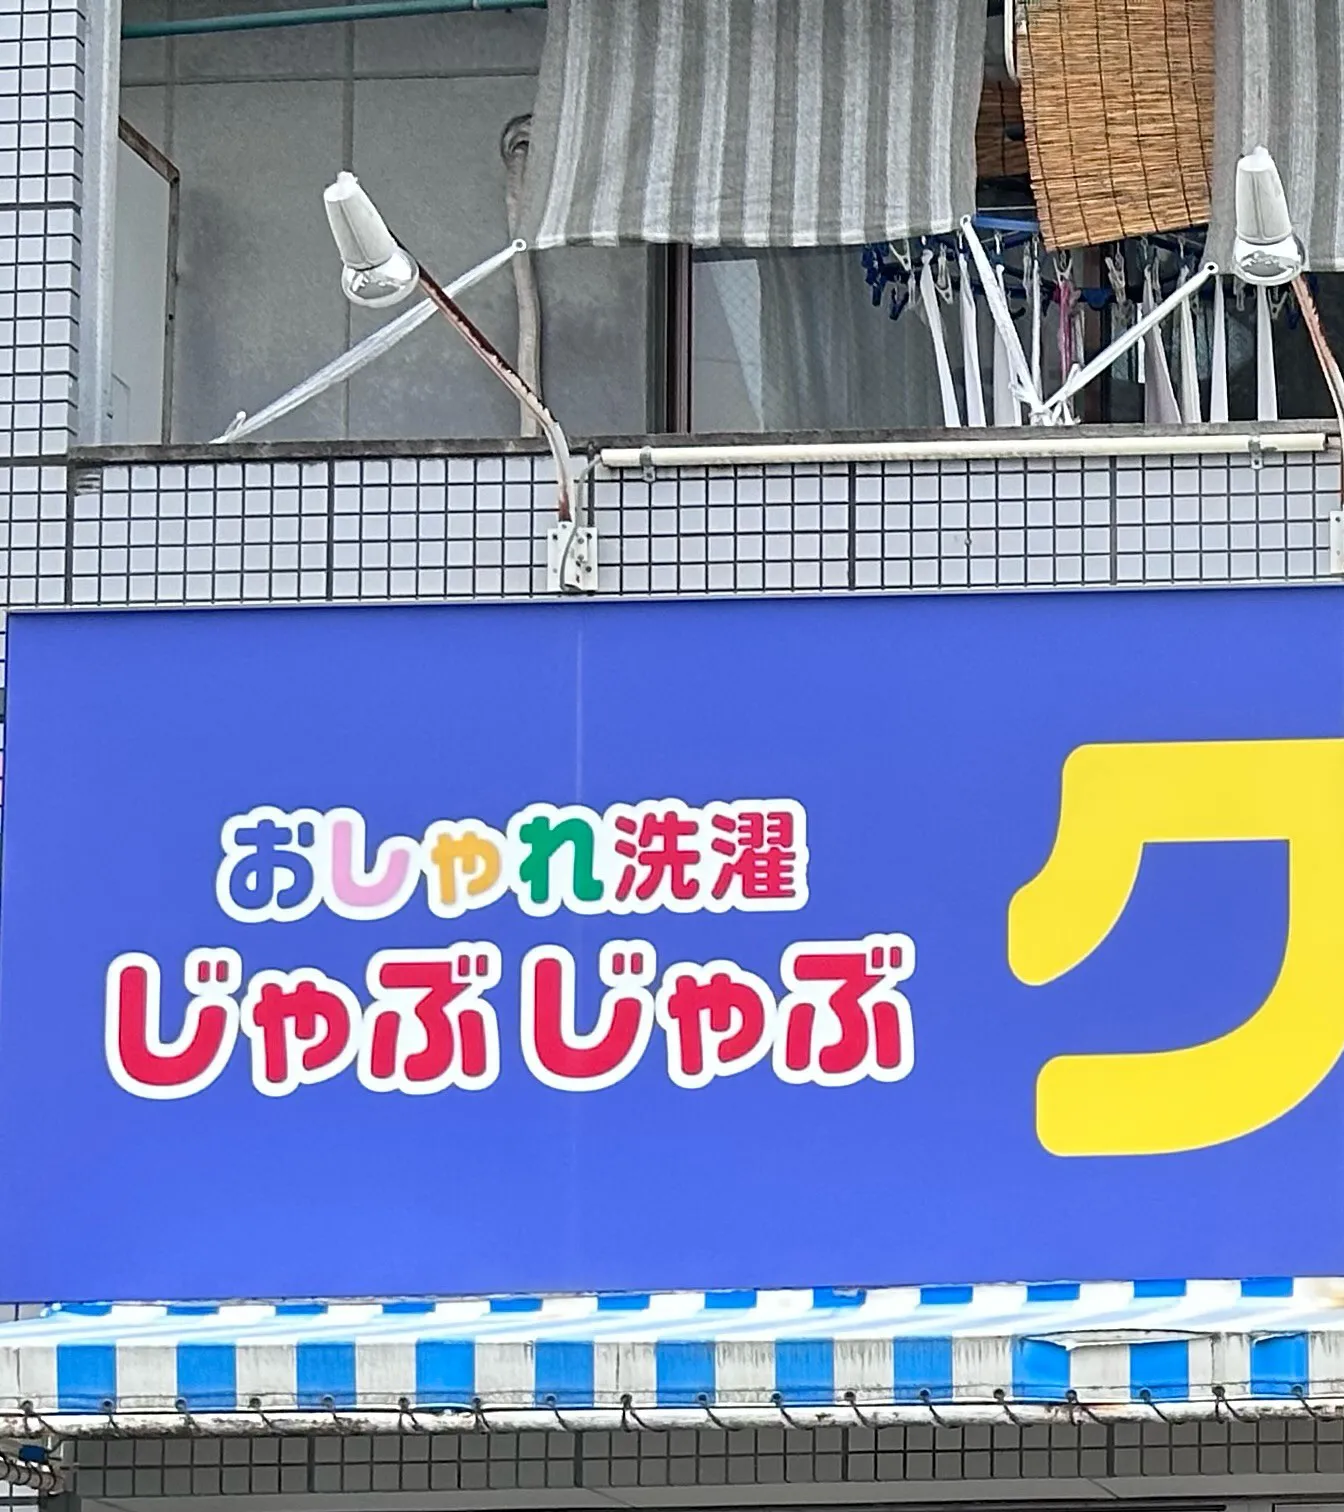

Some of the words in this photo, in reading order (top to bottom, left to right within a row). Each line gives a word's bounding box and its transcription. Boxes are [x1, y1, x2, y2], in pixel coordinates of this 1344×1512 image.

[225, 808, 801, 913] おしゃれ洗濯
